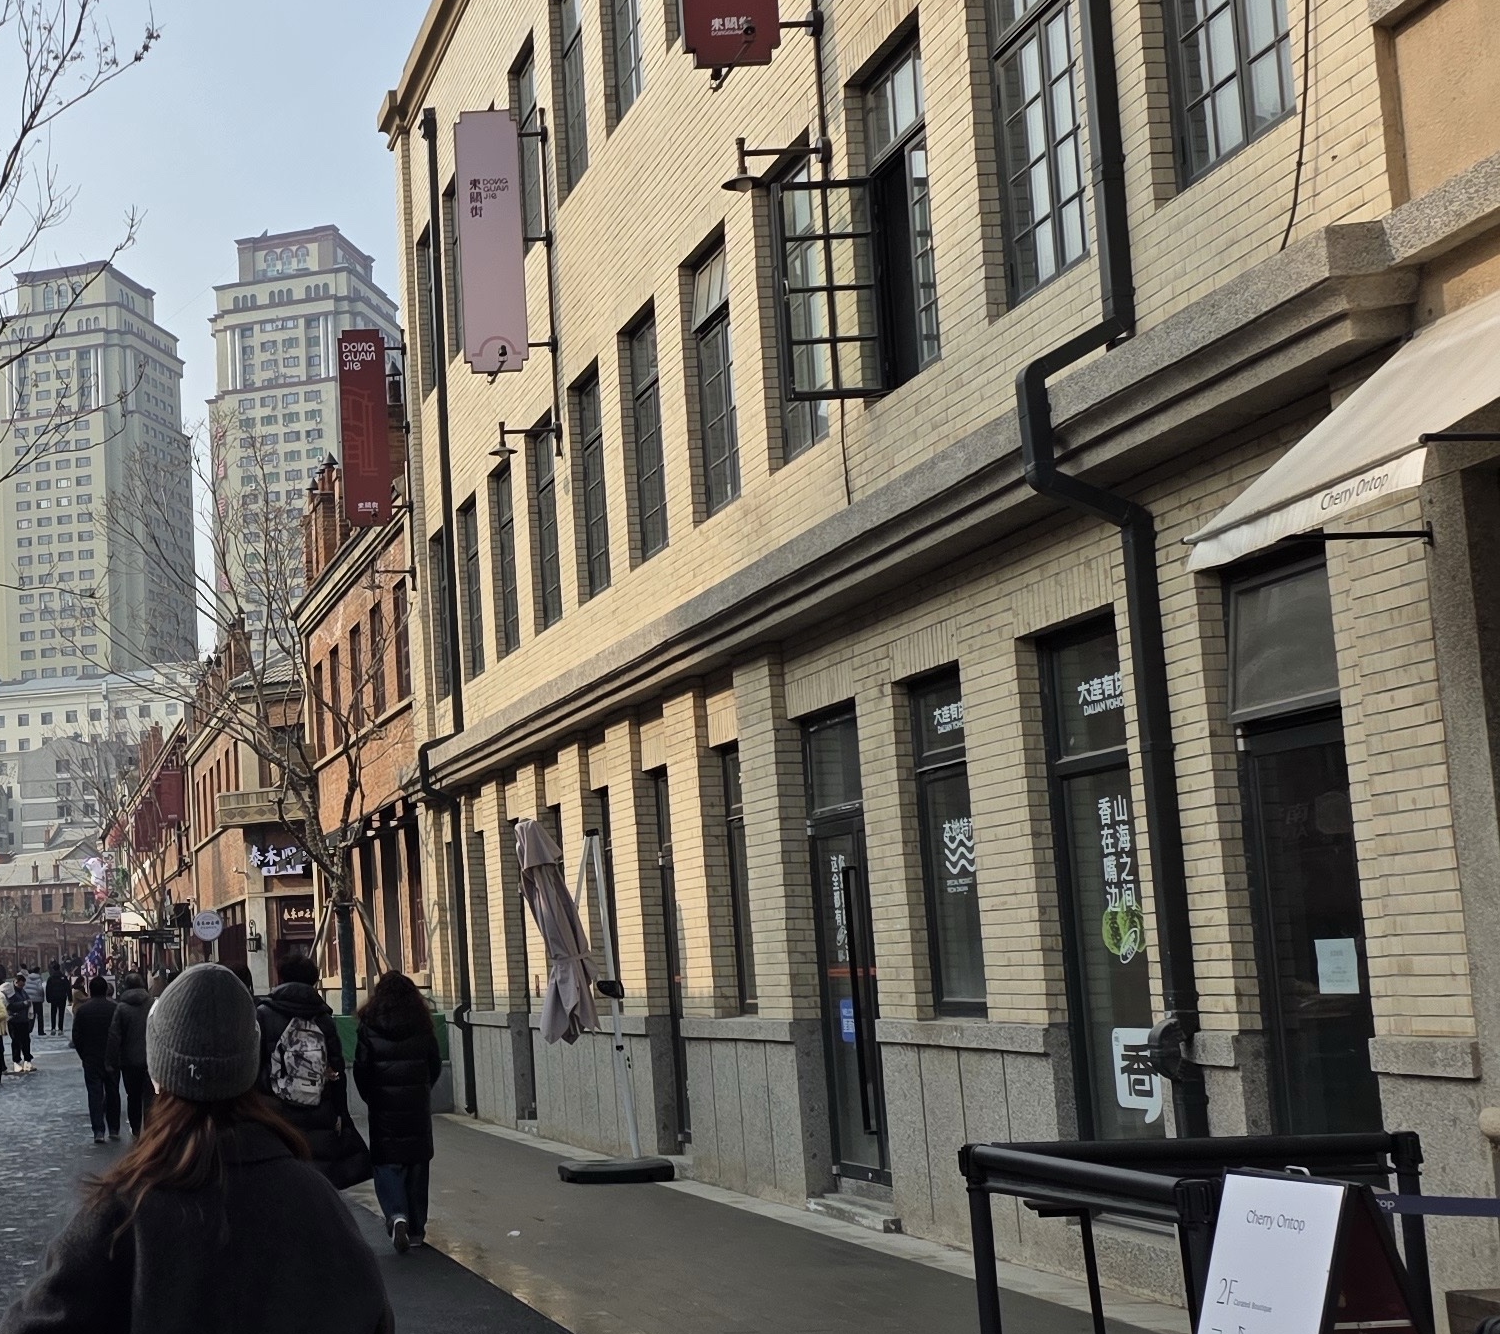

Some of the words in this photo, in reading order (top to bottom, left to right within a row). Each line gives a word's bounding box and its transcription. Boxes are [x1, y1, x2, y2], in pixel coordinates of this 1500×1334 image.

[342, 342, 375, 352] DONG
[342, 351, 376, 361] GUAN
[1320, 486, 1355, 511] Cherry
[1097, 796, 1121, 912] 香在嘴边
[1113, 794, 1136, 912] 山海之间
[1246, 1209, 1275, 1230] Cherry
[1276, 1214, 1306, 1234] Ontop
[1216, 1277, 1239, 1306] 2F
